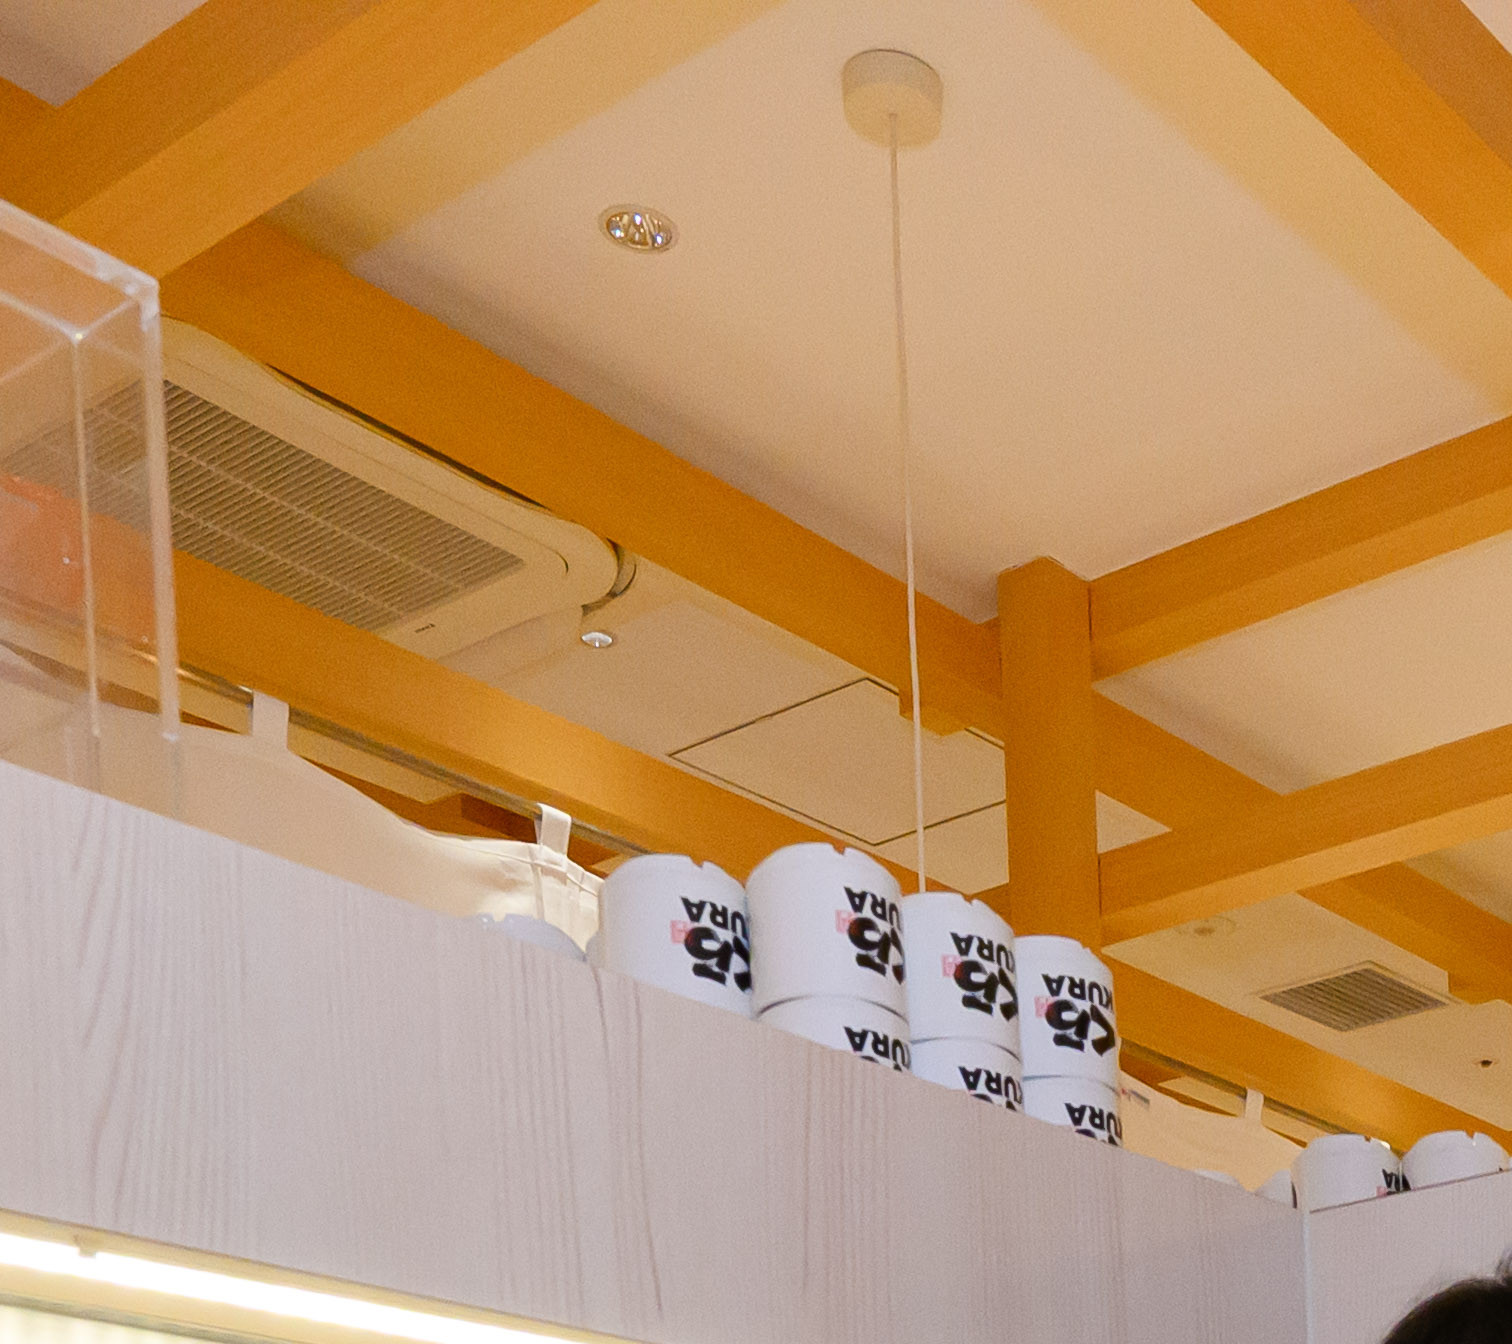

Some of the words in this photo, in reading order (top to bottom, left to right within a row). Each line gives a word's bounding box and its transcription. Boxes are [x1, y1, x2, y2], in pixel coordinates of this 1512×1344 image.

[680, 896, 749, 947] URA
[844, 886, 902, 936] URA
[1045, 999, 1116, 1057] くら
